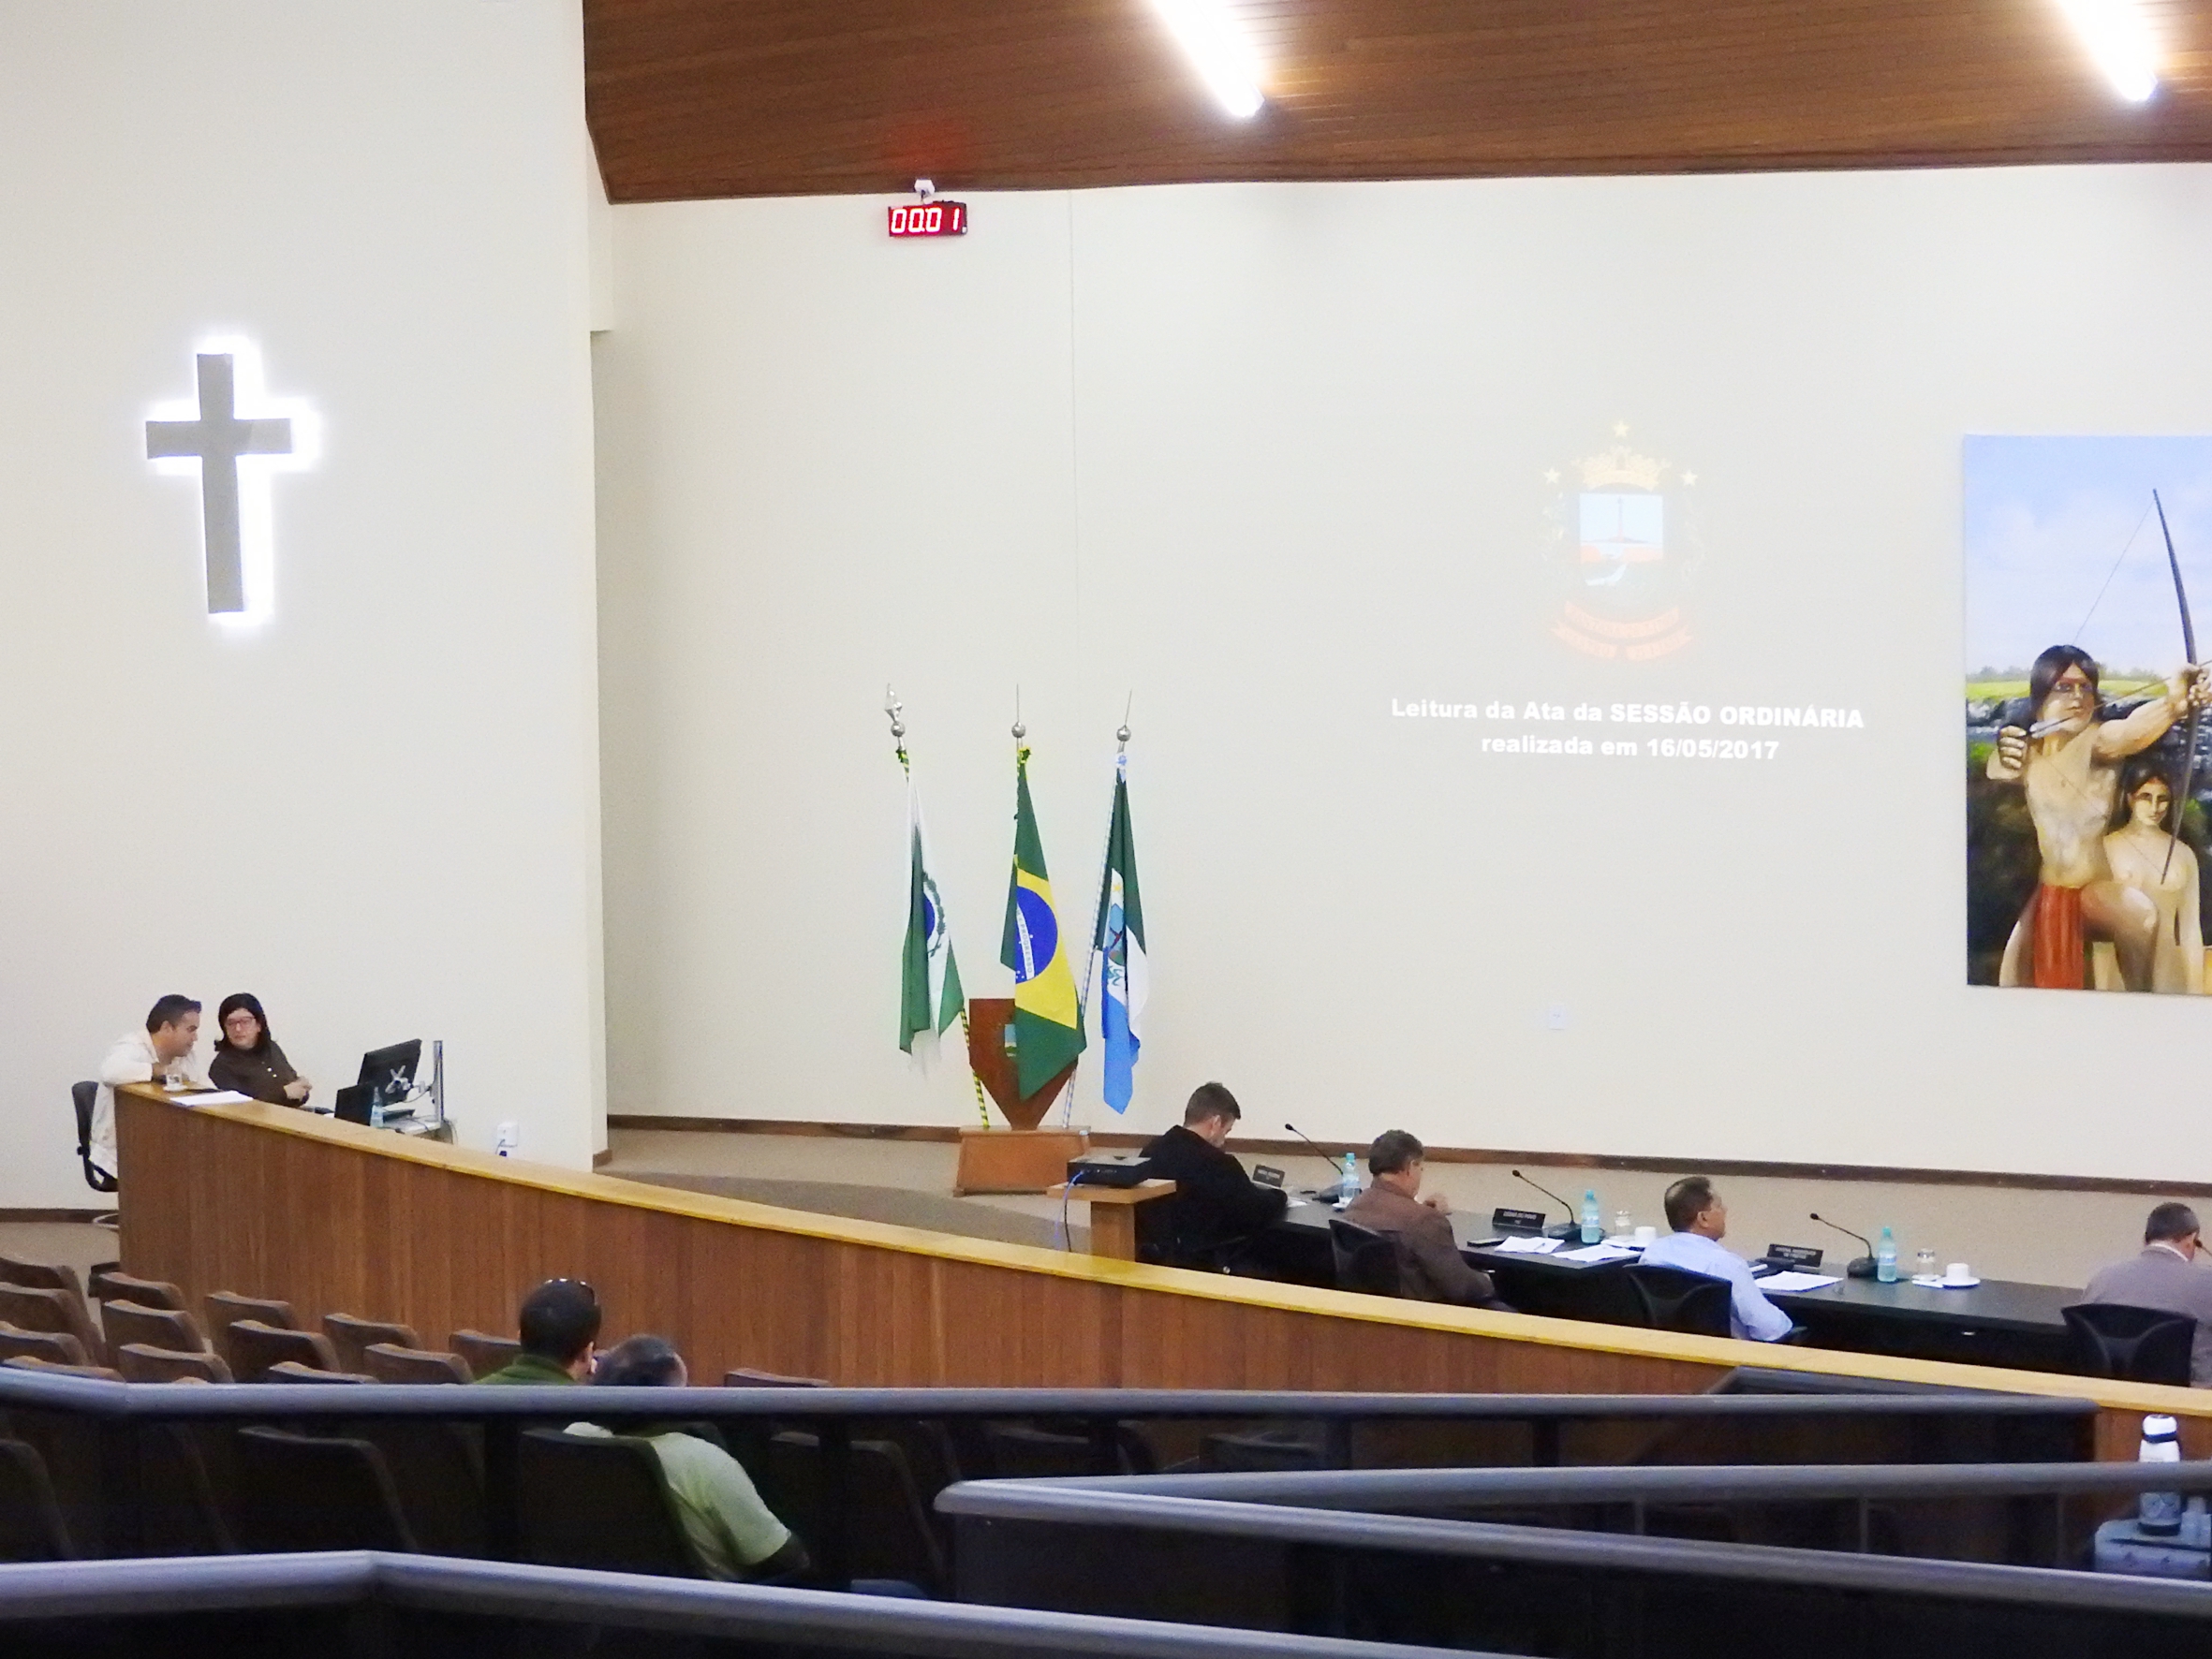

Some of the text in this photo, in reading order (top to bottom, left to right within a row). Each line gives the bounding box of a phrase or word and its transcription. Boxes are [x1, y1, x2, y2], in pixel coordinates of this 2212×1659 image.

[1392, 697, 1865, 728] Leitura da Ata da SESSÃO ORDINÁRIA
[1482, 734, 1779, 760] realizada em 16/05/2017
